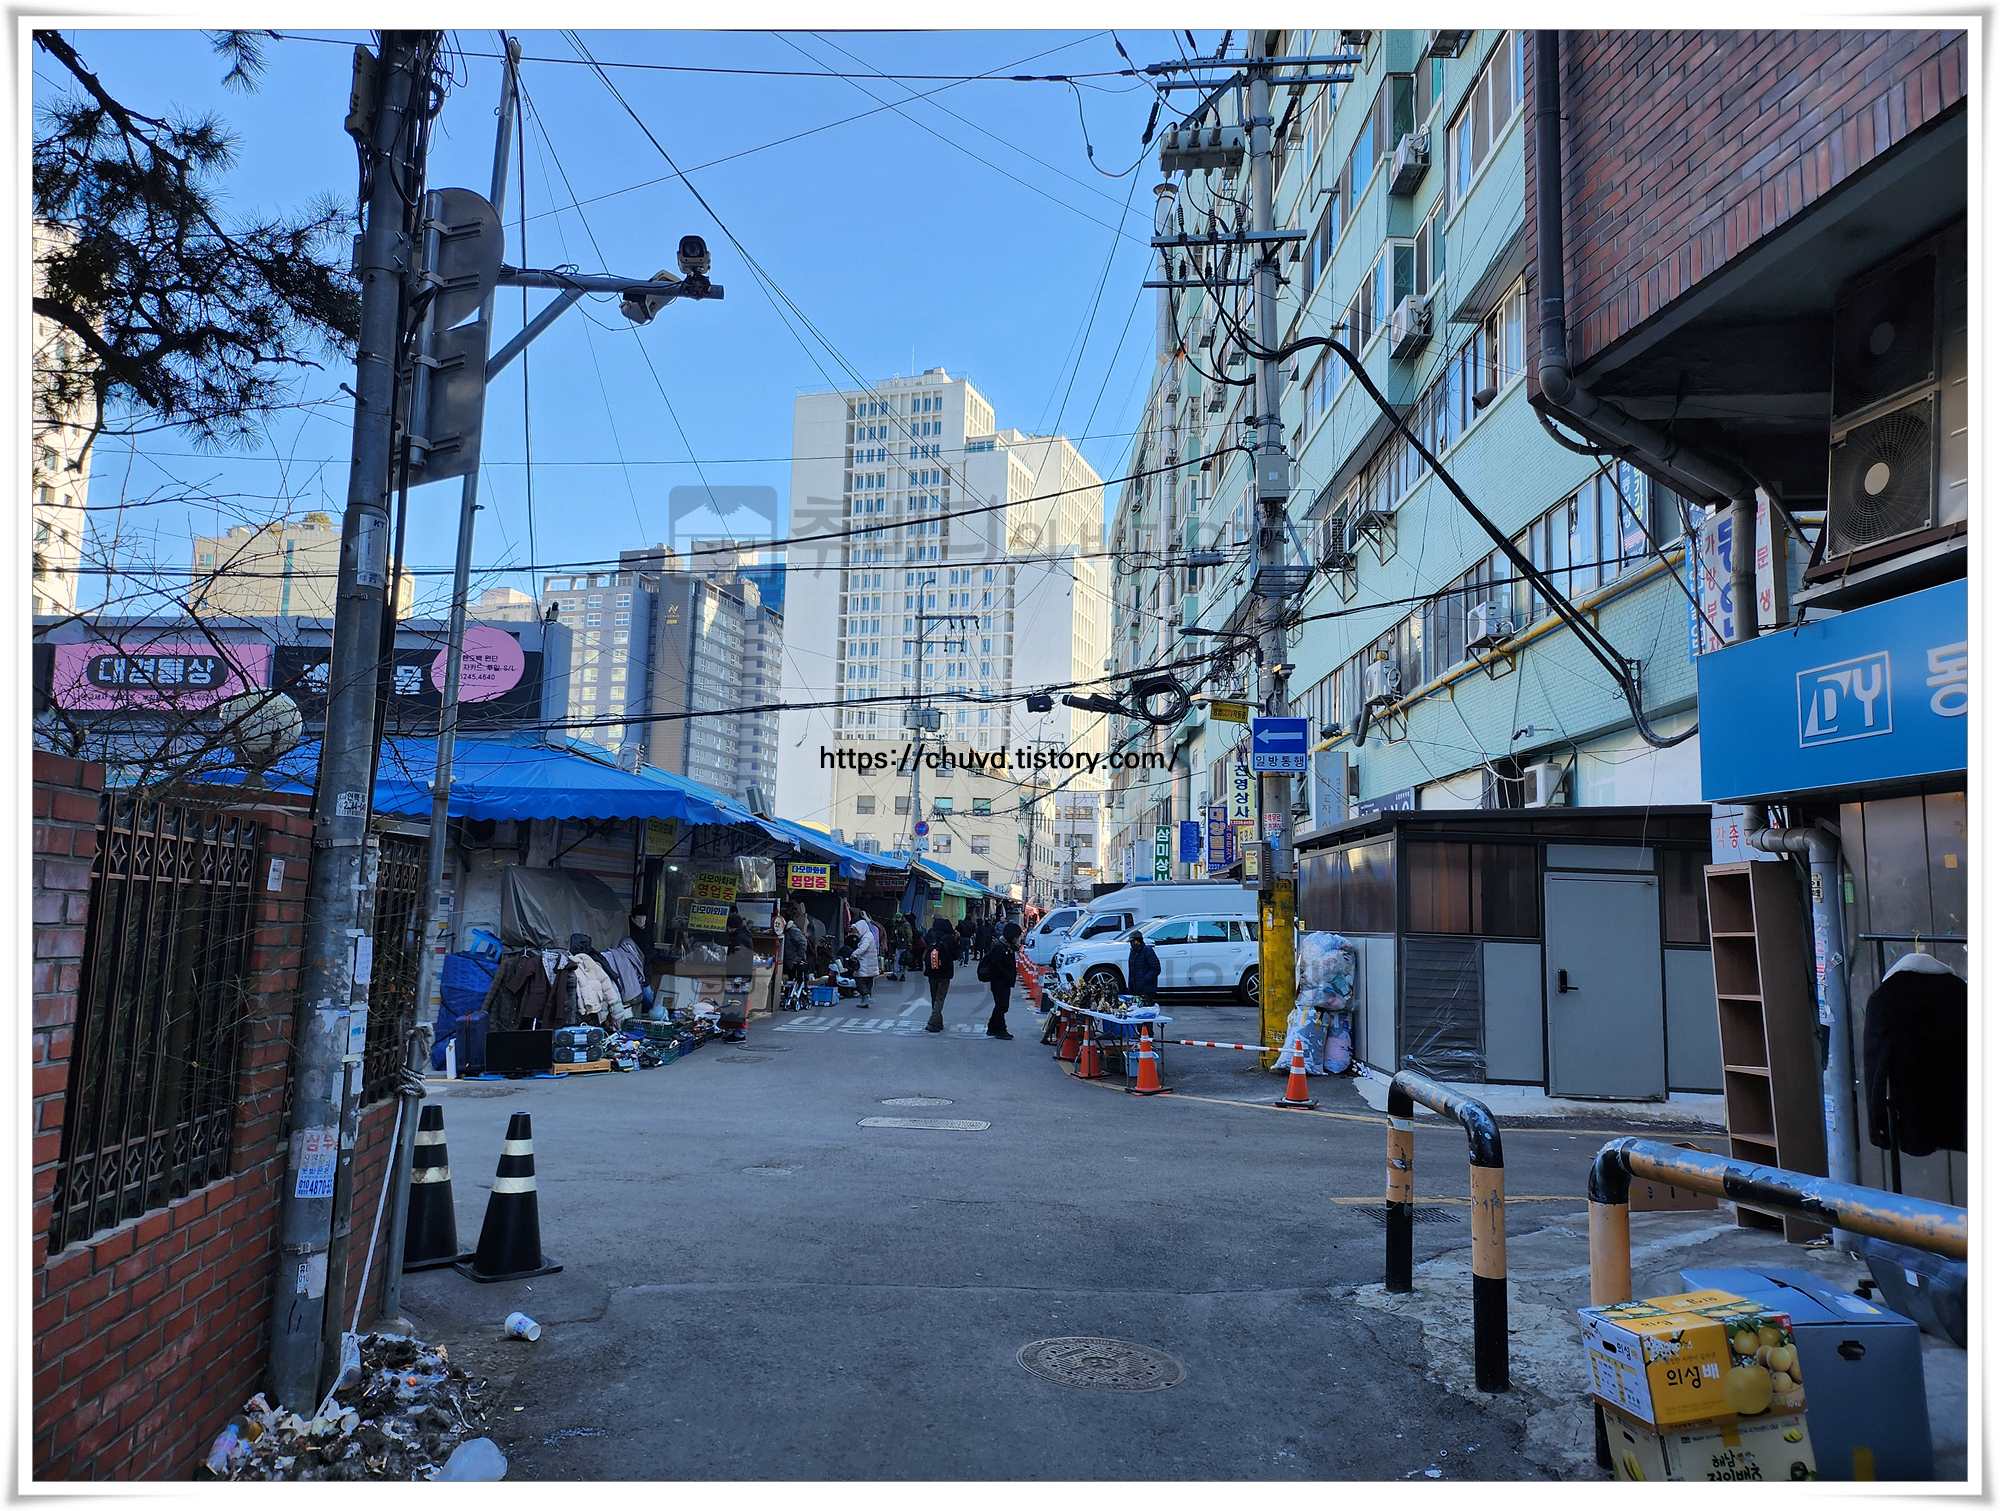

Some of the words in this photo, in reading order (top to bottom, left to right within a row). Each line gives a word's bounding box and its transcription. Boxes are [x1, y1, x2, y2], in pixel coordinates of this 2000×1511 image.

[1255, 755, 1304, 768] 일방통행
[791, 875, 827, 888] 영업중
[698, 884, 735, 901] 영업중
[1666, 1363, 1721, 1390] 의성배
